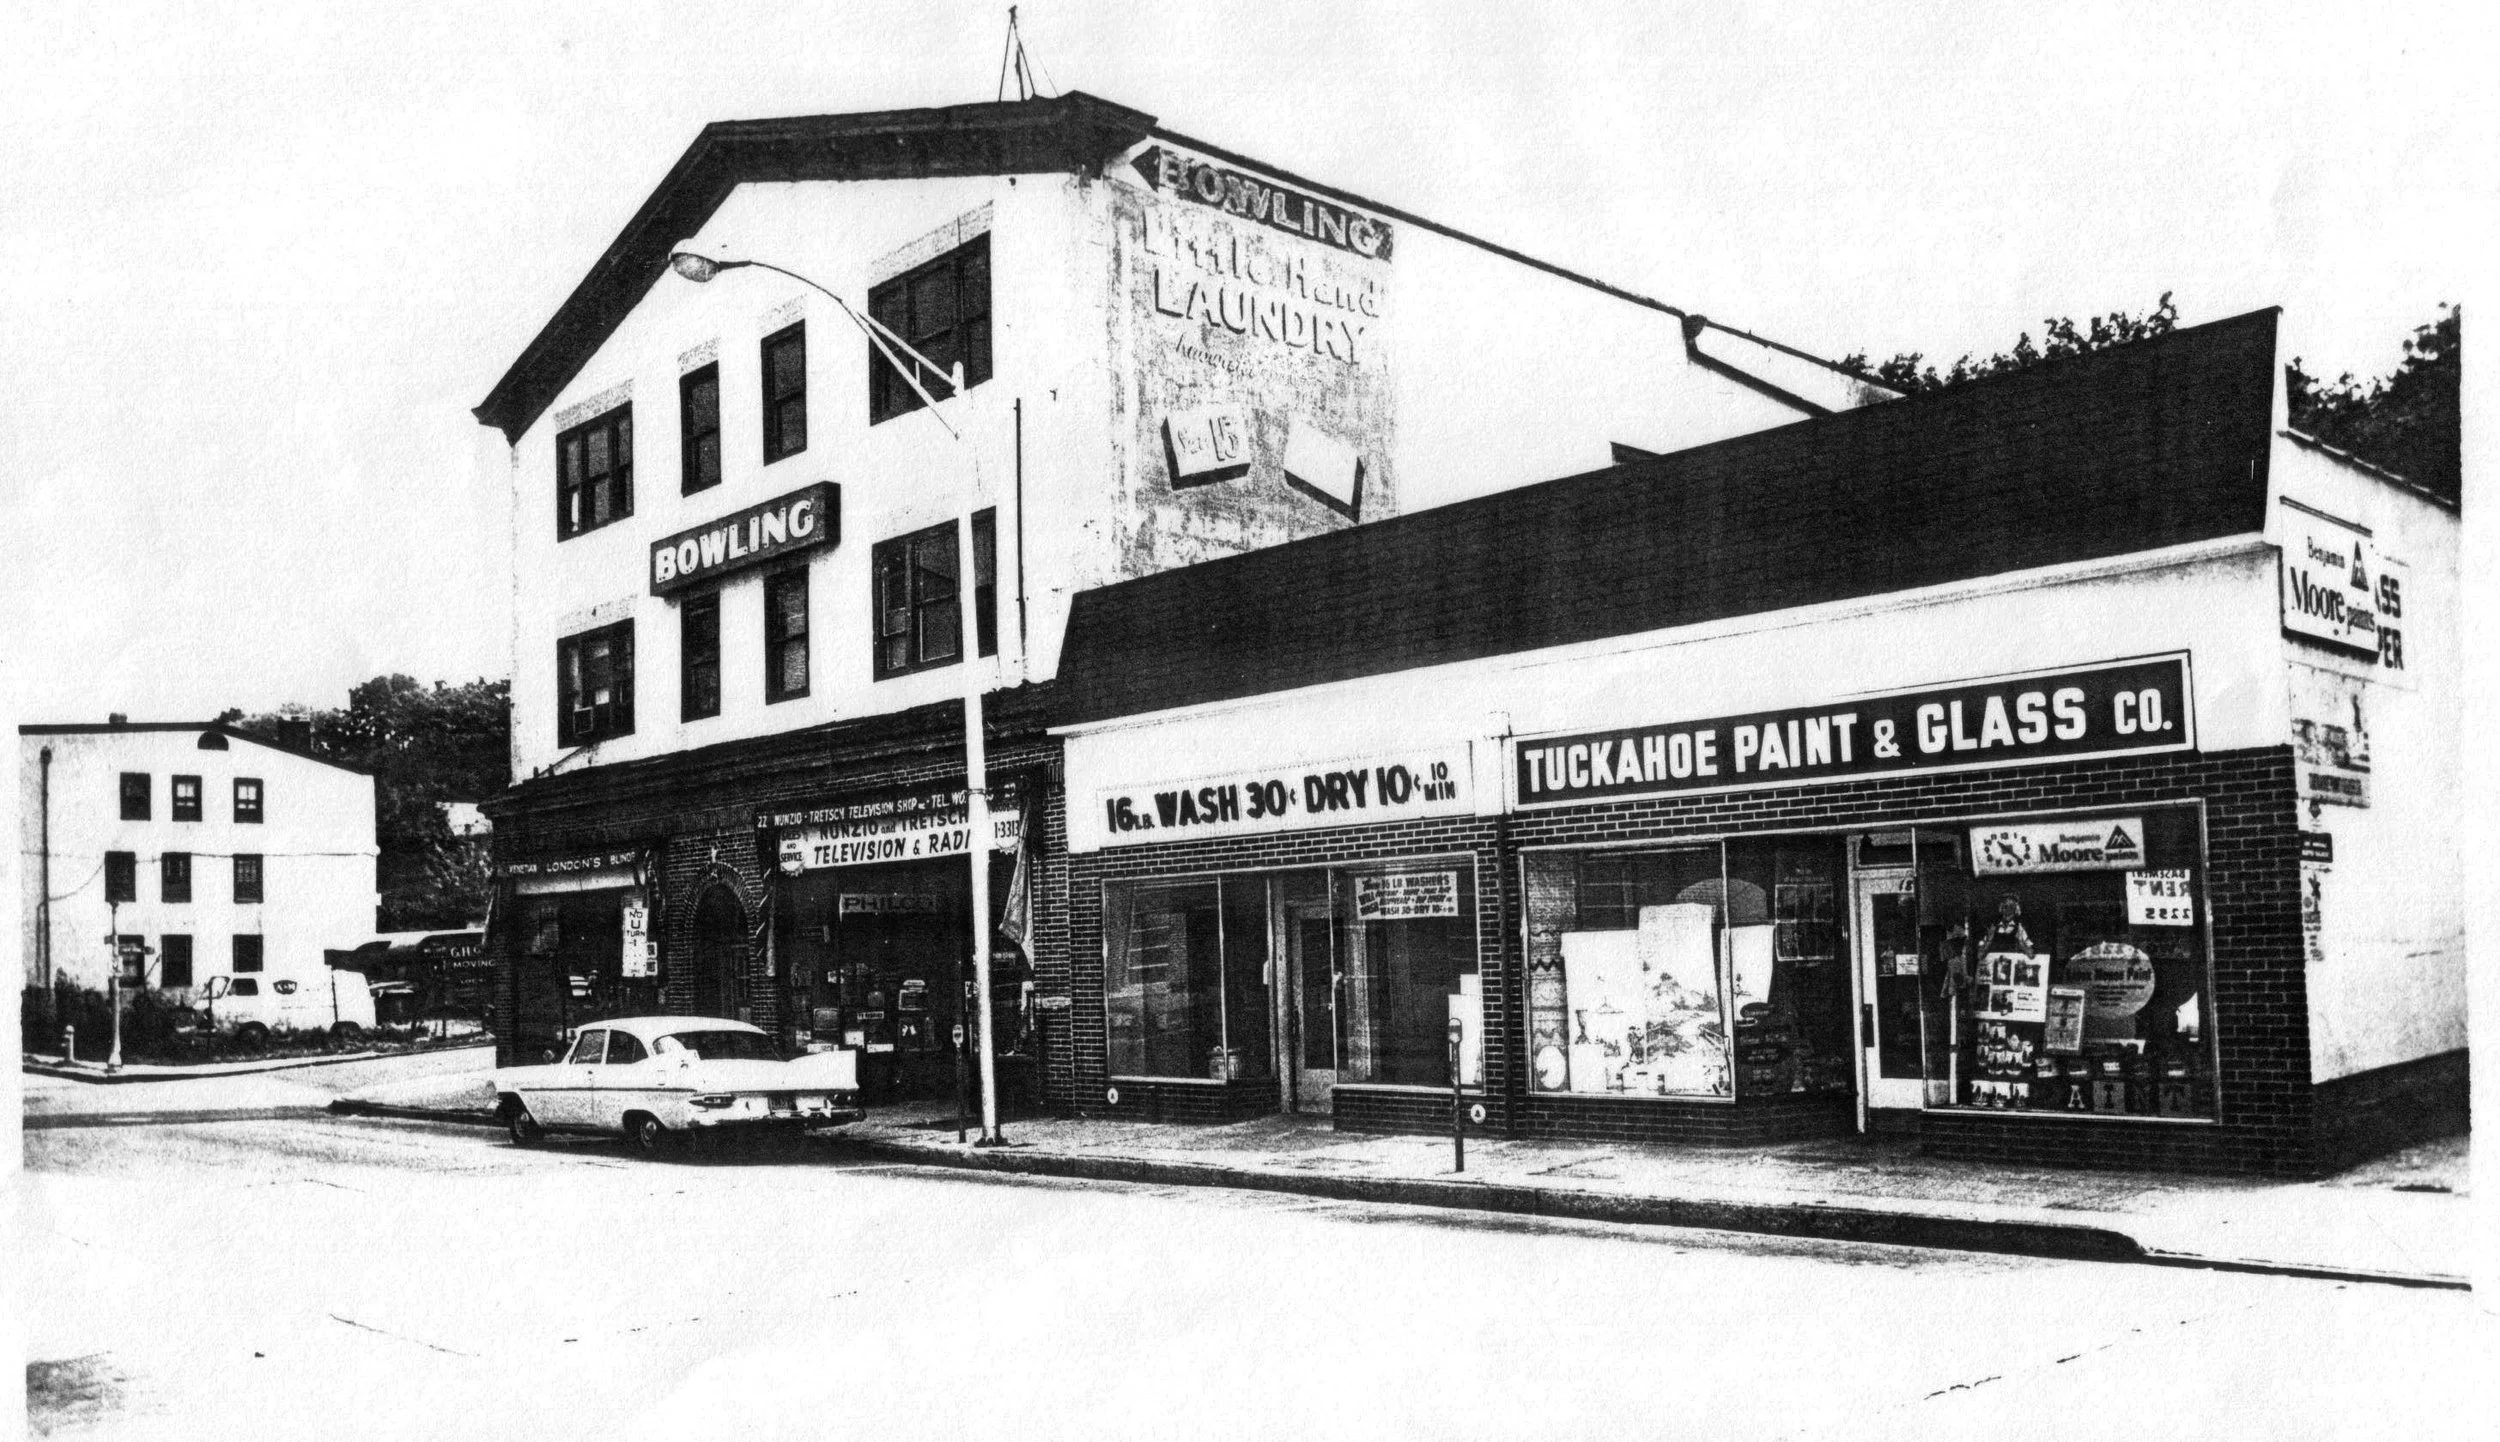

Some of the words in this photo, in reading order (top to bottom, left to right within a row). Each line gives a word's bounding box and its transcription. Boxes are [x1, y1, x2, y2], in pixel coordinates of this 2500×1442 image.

[1160, 148, 1383, 256] BOWLING
[1155, 268, 1366, 366] LAUNDRY
[655, 499, 814, 584] BOWLING
[2290, 566, 2345, 624] Moore
[1525, 730, 1718, 793] TUCKAHOE
[1734, 713, 1858, 773] PAINT
[1873, 719, 1901, 758] &
[1916, 687, 2087, 754] GLASS
[2113, 688, 2173, 735] CO.
[1430, 761, 1448, 781] 10
[1154, 783, 1240, 828] WASH
[1303, 769, 1369, 814] DRY
[1423, 781, 1457, 801] MIN
[774, 812, 803, 827] NUNZIO
[848, 801, 894, 819] TELEVISION
[896, 797, 918, 813] SHOP
[820, 821, 880, 841] NUNZIO
[900, 812, 969, 832] TRETSCH
[780, 852, 802, 862] SERVICE
[814, 837, 907, 865] TELEVISION
[913, 838, 921, 856] &
[929, 828, 971, 854] RADI
[2039, 843, 2104, 863] Moore
[546, 856, 602, 873] LONDON'S
[629, 910, 643, 919] NO
[844, 897, 934, 910] PHILCO
[626, 930, 646, 938] TURN
[630, 919, 641, 930] U
